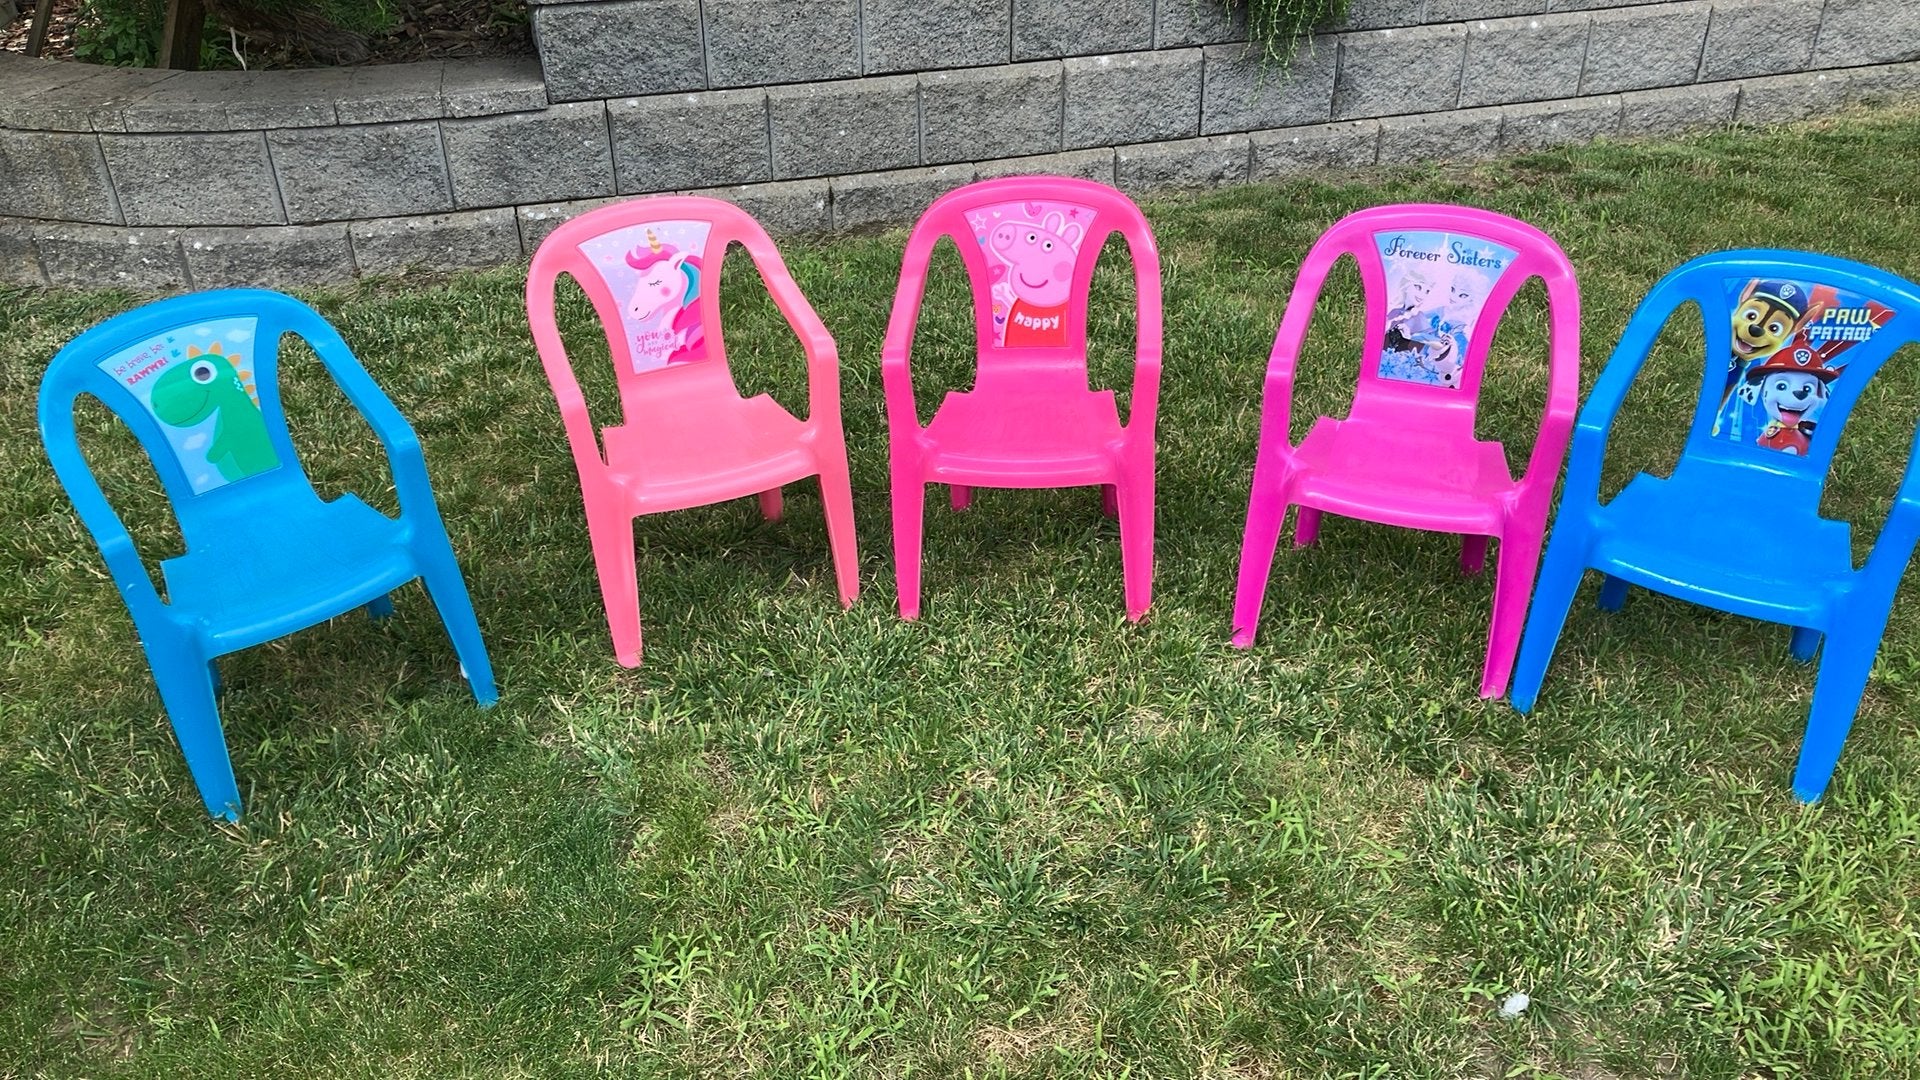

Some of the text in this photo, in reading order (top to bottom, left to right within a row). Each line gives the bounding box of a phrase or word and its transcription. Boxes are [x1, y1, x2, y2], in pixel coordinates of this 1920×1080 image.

[1384, 235, 1502, 269] Forever Sisters
[1014, 312, 1060, 331] happy
[1822, 308, 1871, 325] PAW
[635, 331, 660, 354] you
